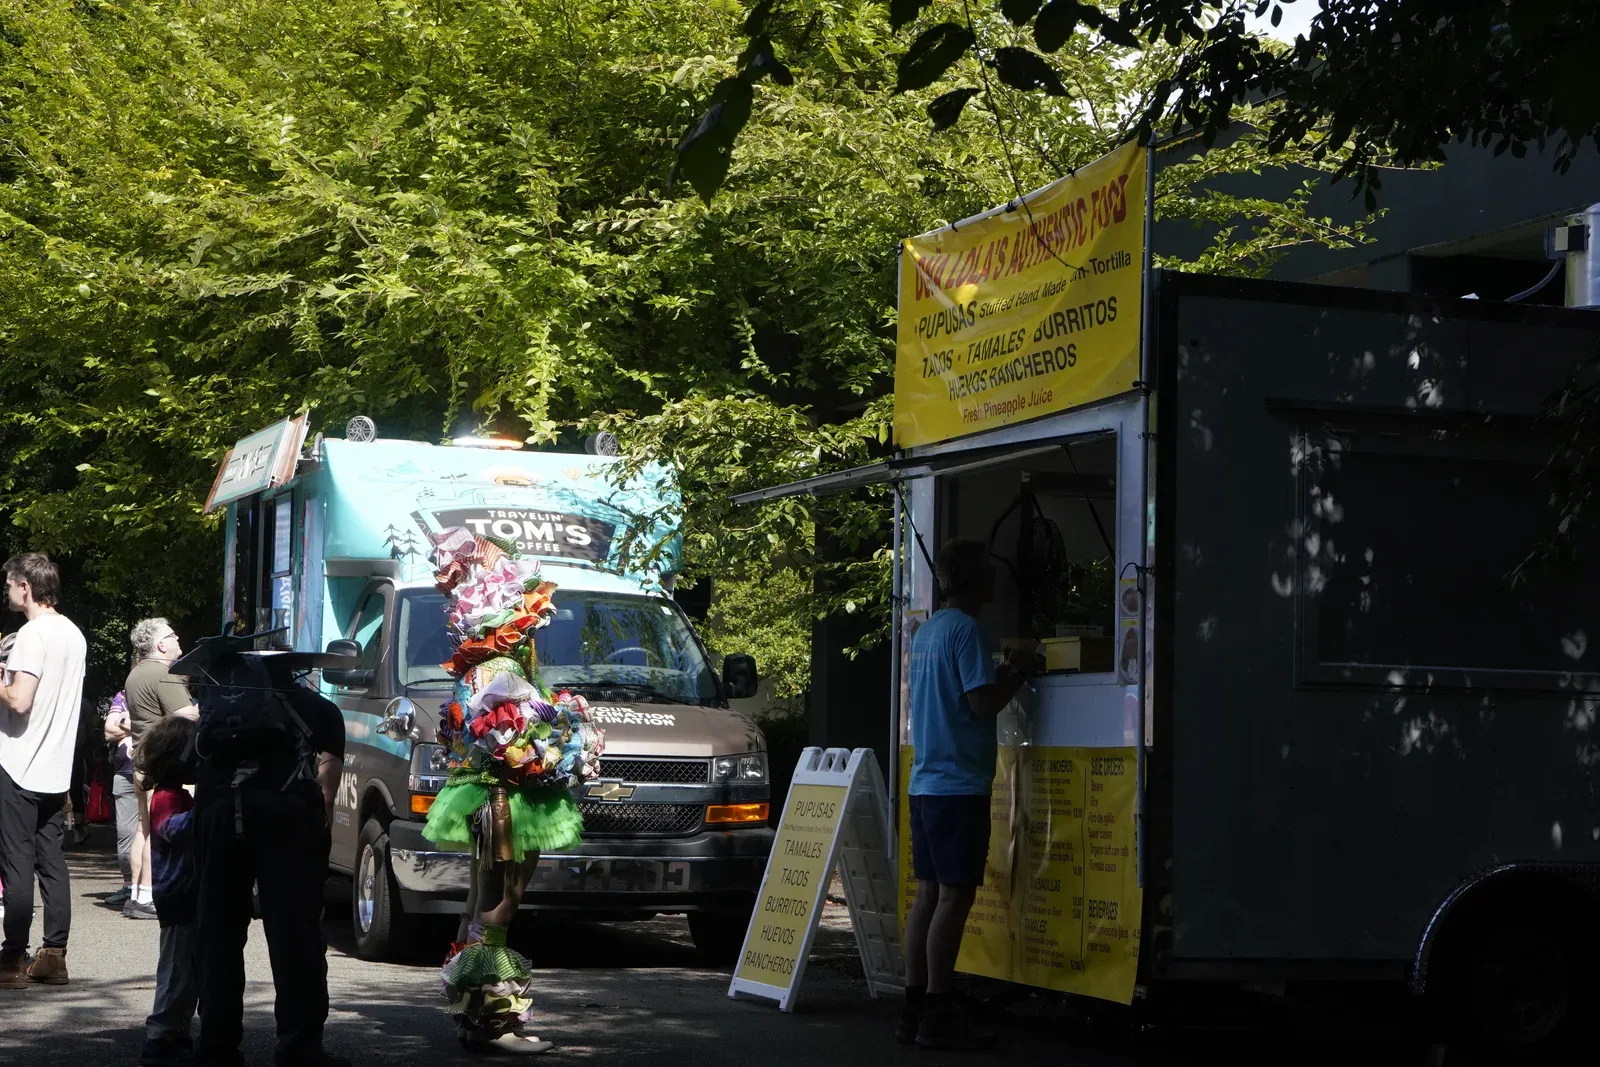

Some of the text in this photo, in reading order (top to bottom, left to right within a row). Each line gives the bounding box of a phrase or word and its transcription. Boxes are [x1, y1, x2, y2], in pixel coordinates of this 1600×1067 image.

[919, 301, 977, 340] PUPUSAS
[979, 294, 1014, 319] Stuffed
[1015, 286, 1040, 308] Hand
[1041, 273, 1067, 299] Made
[1089, 250, 1132, 276] Tortilla
[922, 295, 1118, 378] TACOS TAMALES BURRITOS
[948, 342, 1077, 402] HUEVOS RANCHEROS
[962, 388, 1053, 425] Fresh Pineapple Juice
[488, 509, 564, 522] TRAVELIN'
[465, 518, 592, 546] TOM'S
[516, 541, 560, 553] OFFEE
[593, 716, 675, 726] TINATION
[595, 711, 676, 721] EINATION
[334, 771, 357, 810] M'S
[795, 800, 835, 819] PUPUSAS
[784, 840, 823, 859] TAMALES
[781, 868, 809, 887] TACOS
[765, 896, 808, 917] BURRITOS
[760, 925, 796, 945] HUEVOS
[744, 951, 795, 975] RANCHEROS
